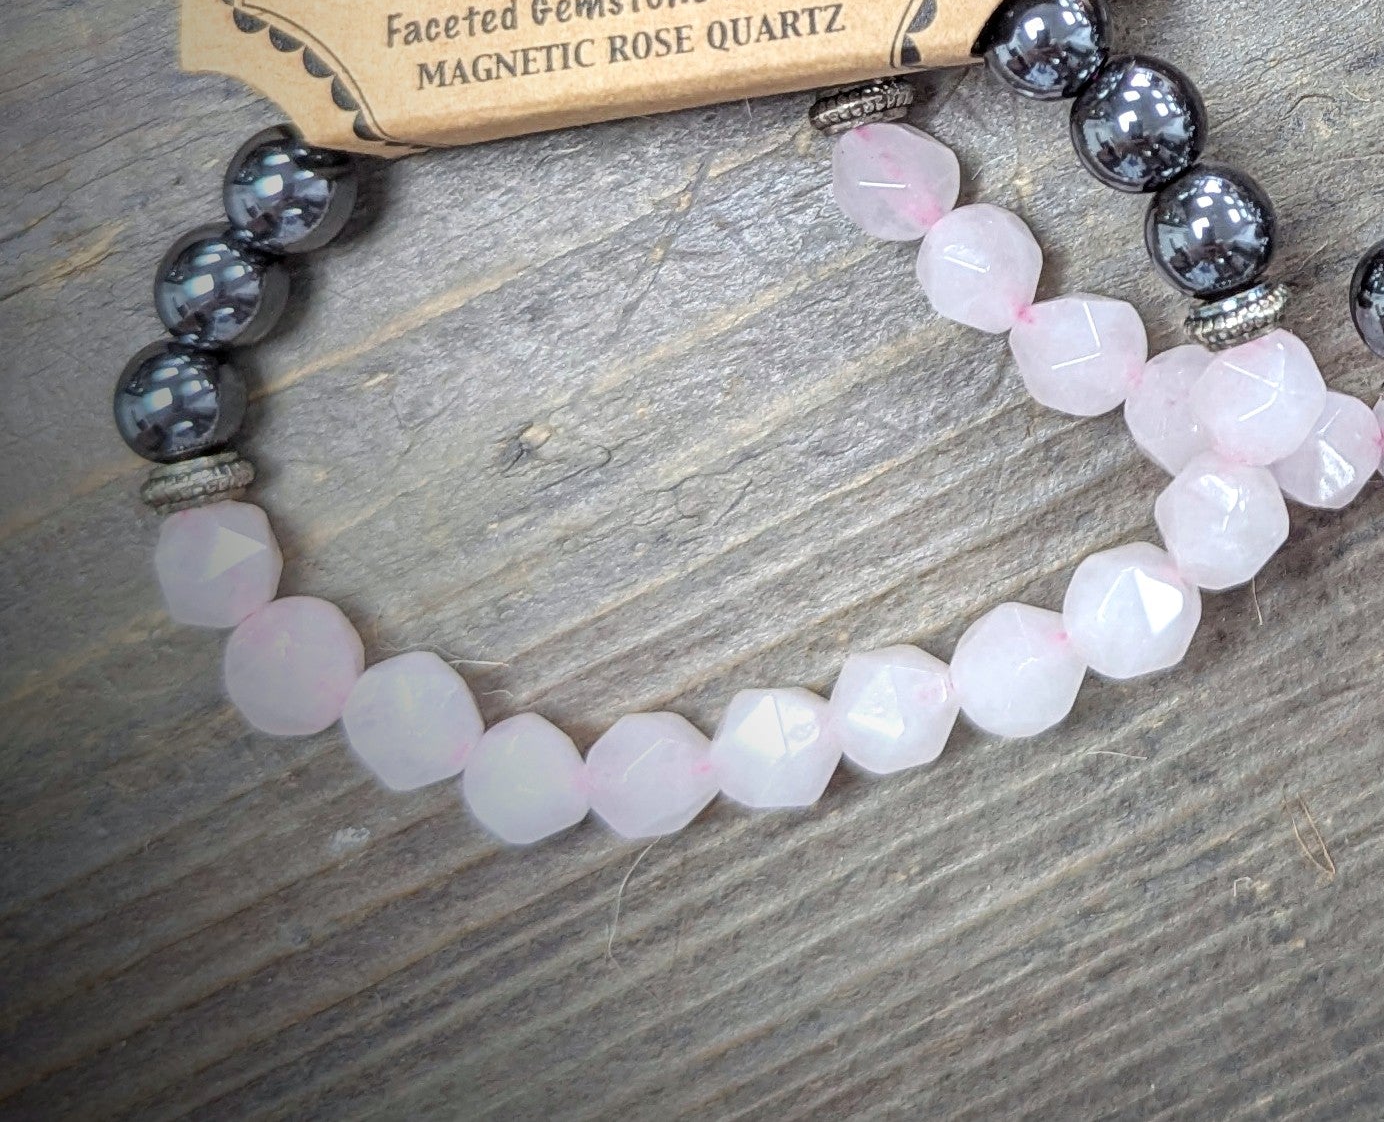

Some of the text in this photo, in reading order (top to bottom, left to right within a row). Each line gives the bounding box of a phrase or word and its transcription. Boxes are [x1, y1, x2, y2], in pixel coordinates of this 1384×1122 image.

[417, 4, 845, 90] MAGNETIC ROSE QUARTZ
